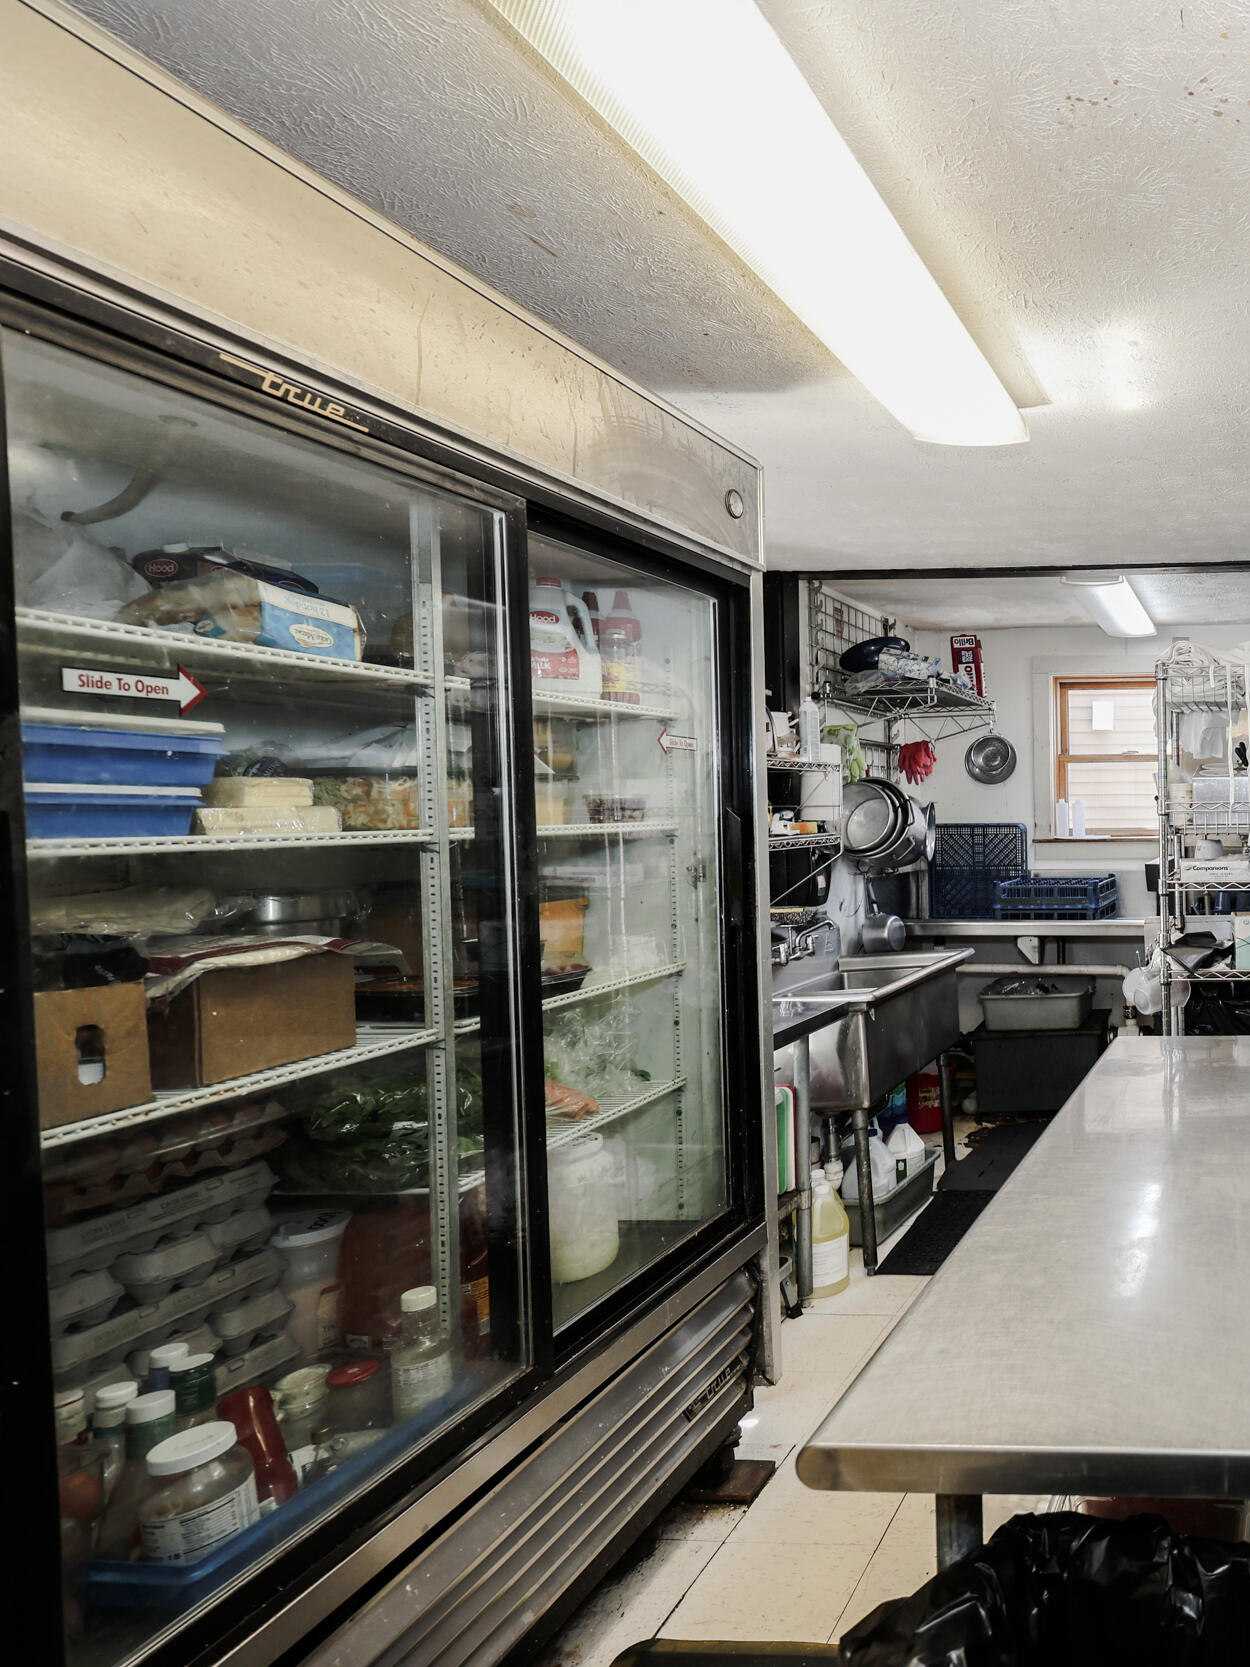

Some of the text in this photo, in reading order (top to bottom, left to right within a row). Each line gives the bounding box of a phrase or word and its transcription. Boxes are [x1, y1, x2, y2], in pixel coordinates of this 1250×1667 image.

[149, 563, 175, 574] Hood
[953, 637, 974, 646] Brillo
[78, 673, 169, 696] Slide To Open
